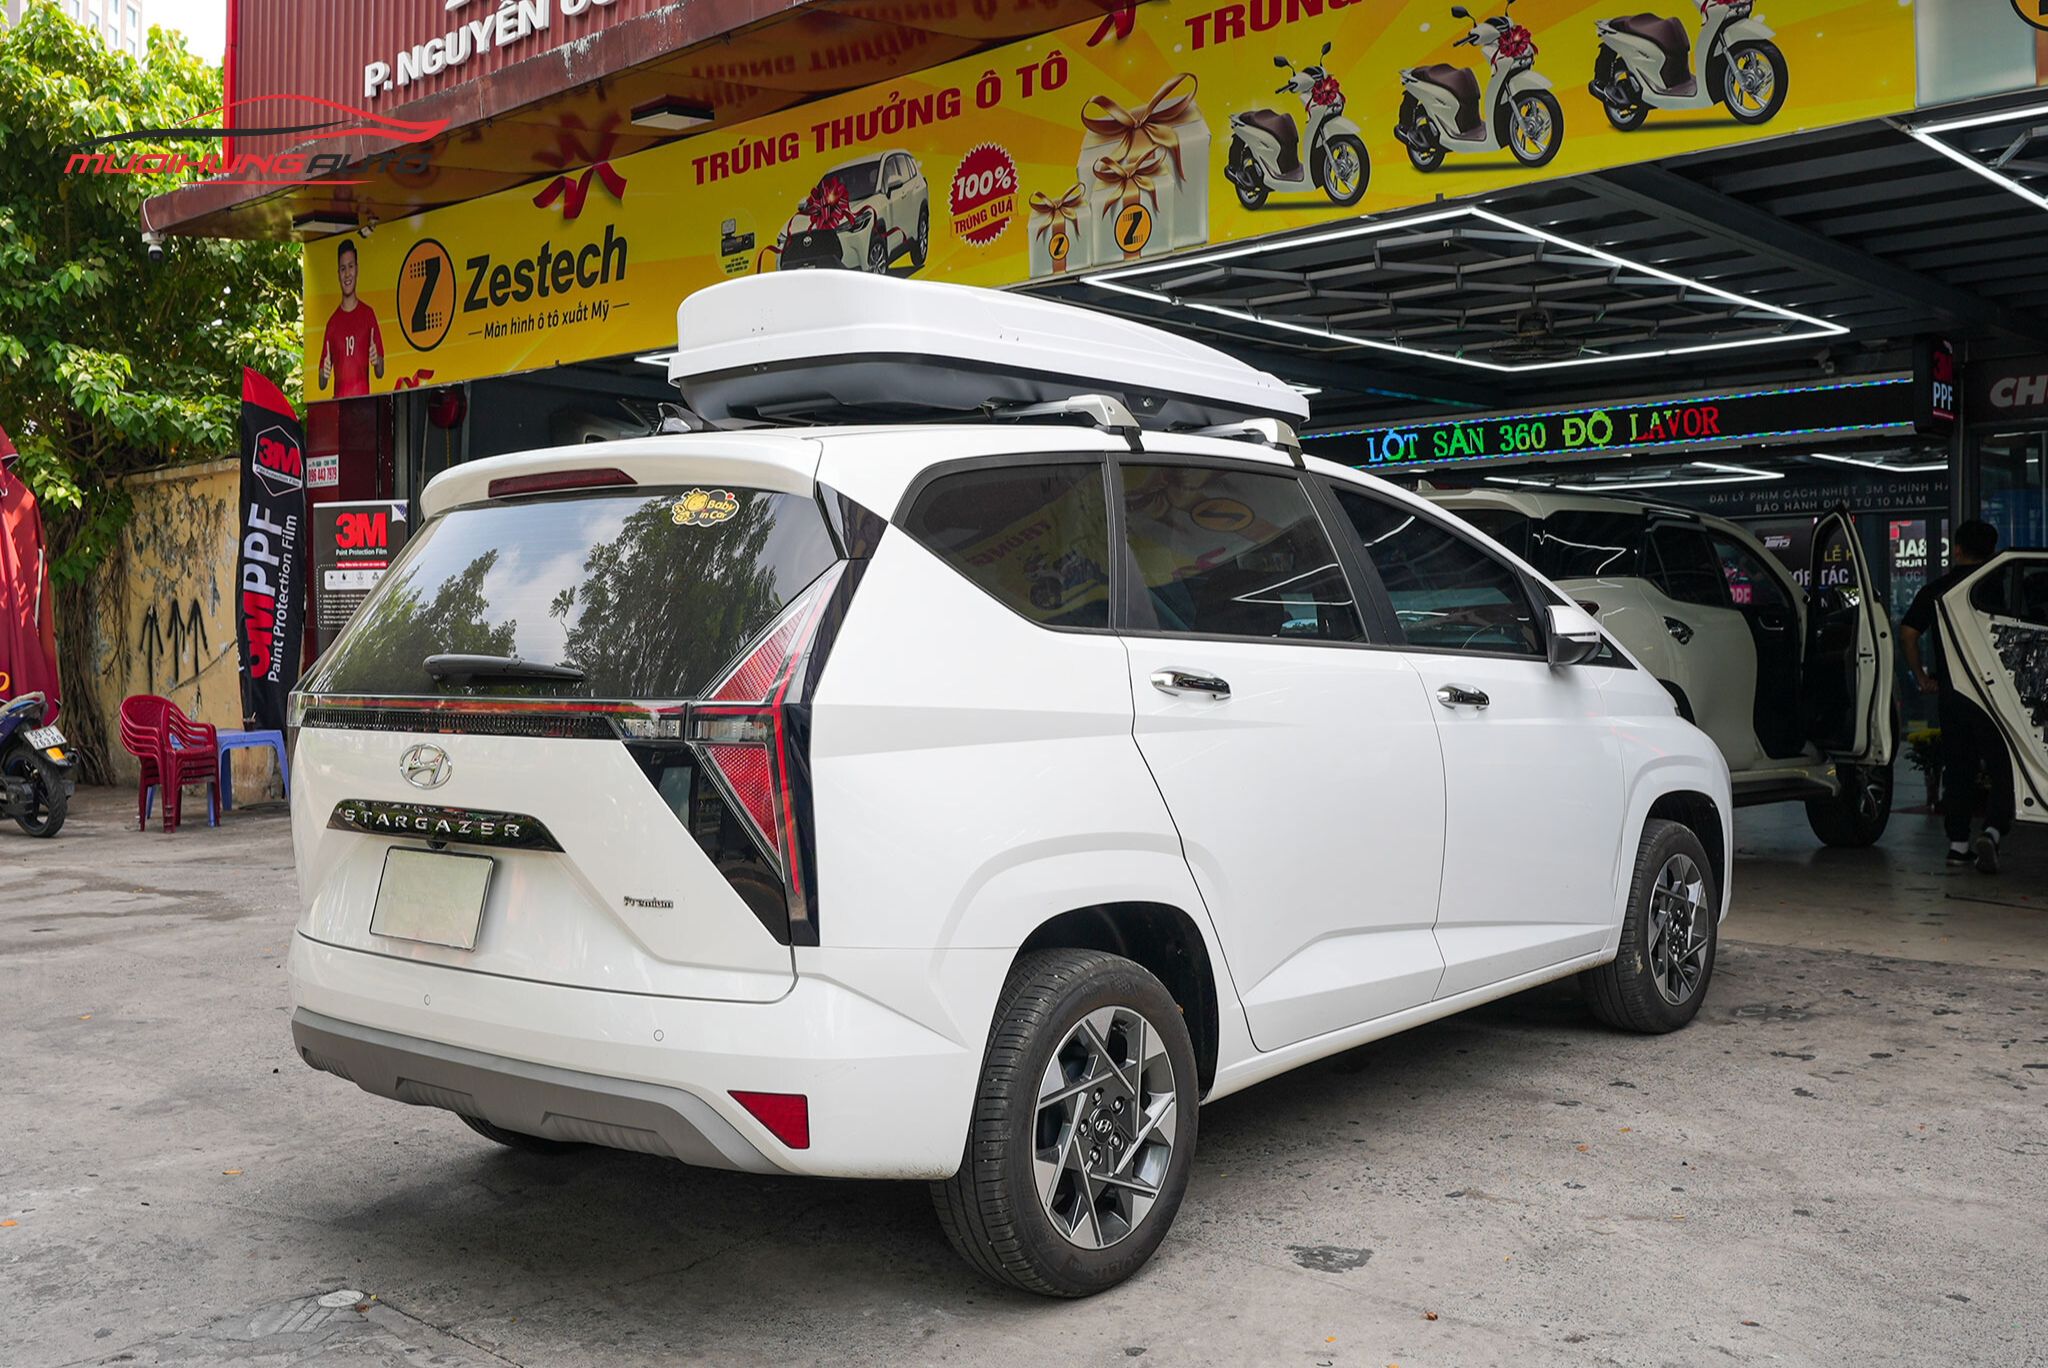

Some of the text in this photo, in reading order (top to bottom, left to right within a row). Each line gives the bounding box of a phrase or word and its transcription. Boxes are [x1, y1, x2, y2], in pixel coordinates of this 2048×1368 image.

[691, 49, 1069, 185] TRÚNG THƯỞNG Ô TÔ
[956, 165, 1012, 201] 100%
[953, 208, 988, 235] TRÚNG
[463, 224, 628, 313] Zestech
[484, 300, 610, 340] Màn hình ô tô xuất Mỹ
[345, 336, 355, 357] 19
[1500, 421, 1547, 452] 360
[1562, 410, 1613, 449] ĐỘ
[1629, 407, 1720, 442] LAVOR
[258, 436, 301, 478] 3M
[707, 500, 736, 513] Baby
[1750, 490, 1779, 500] PHIM
[1876, 497, 1890, 507] 10
[334, 512, 388, 549] 3M
[268, 514, 297, 682] Paint Protection Film
[344, 808, 520, 838] STARGAZER
[623, 895, 674, 909] Premium
